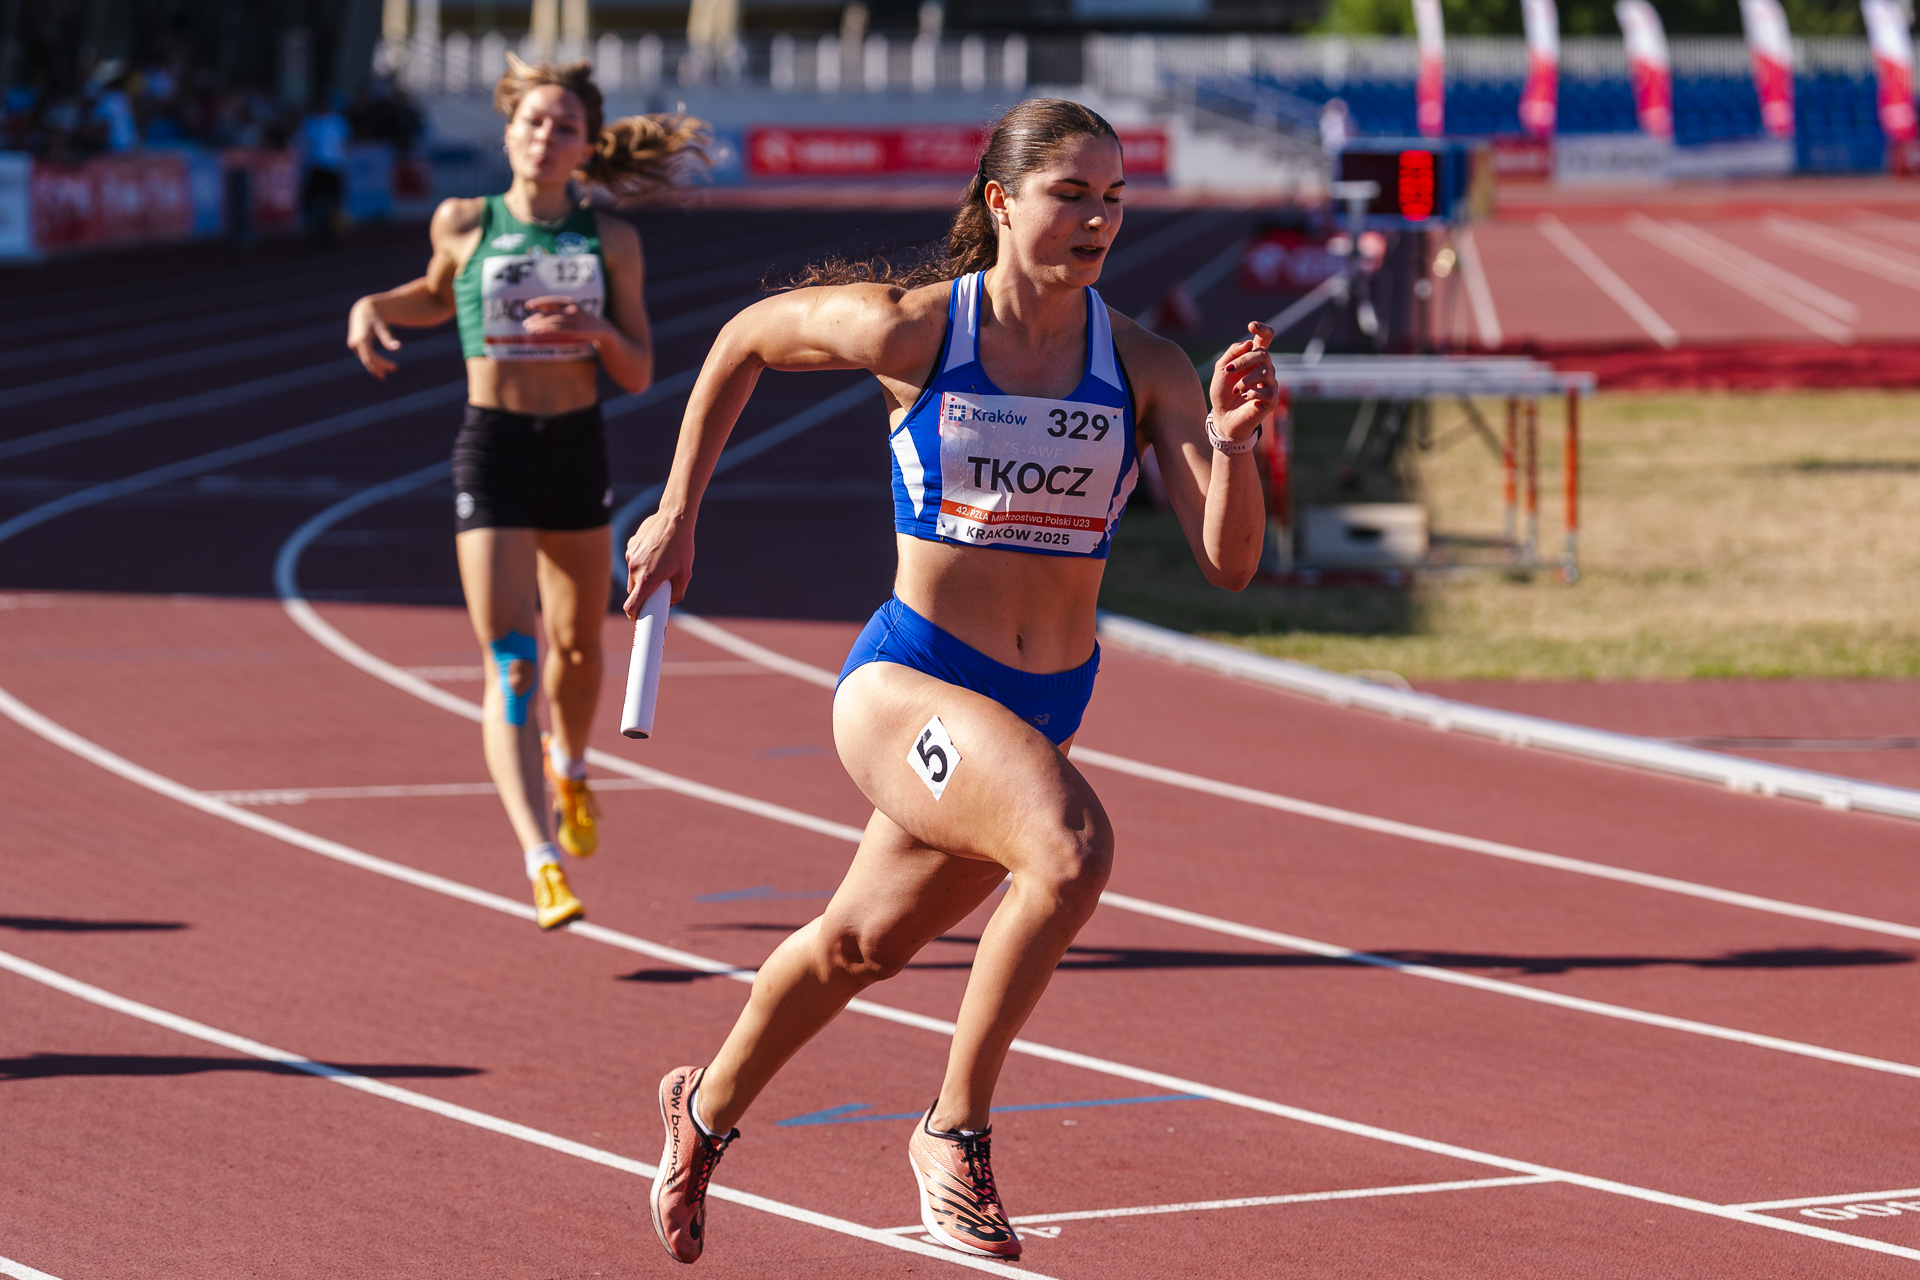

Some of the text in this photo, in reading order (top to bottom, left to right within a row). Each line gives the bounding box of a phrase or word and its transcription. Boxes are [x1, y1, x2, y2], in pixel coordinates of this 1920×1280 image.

[972, 407, 1028, 426] Kraków
[1047, 408, 1110, 442] 329
[967, 456, 1094, 497] TKOCZ
[966, 525, 1070, 546] KRAKÓW 2025
[970, 509, 989, 522] PZLA
[991, 513, 1043, 524] Mistrzostwa
[1045, 515, 1071, 527] Polski
[1073, 517, 1091, 528] U23
[916, 728, 948, 783] 5
[667, 1075, 686, 1189] new balance
